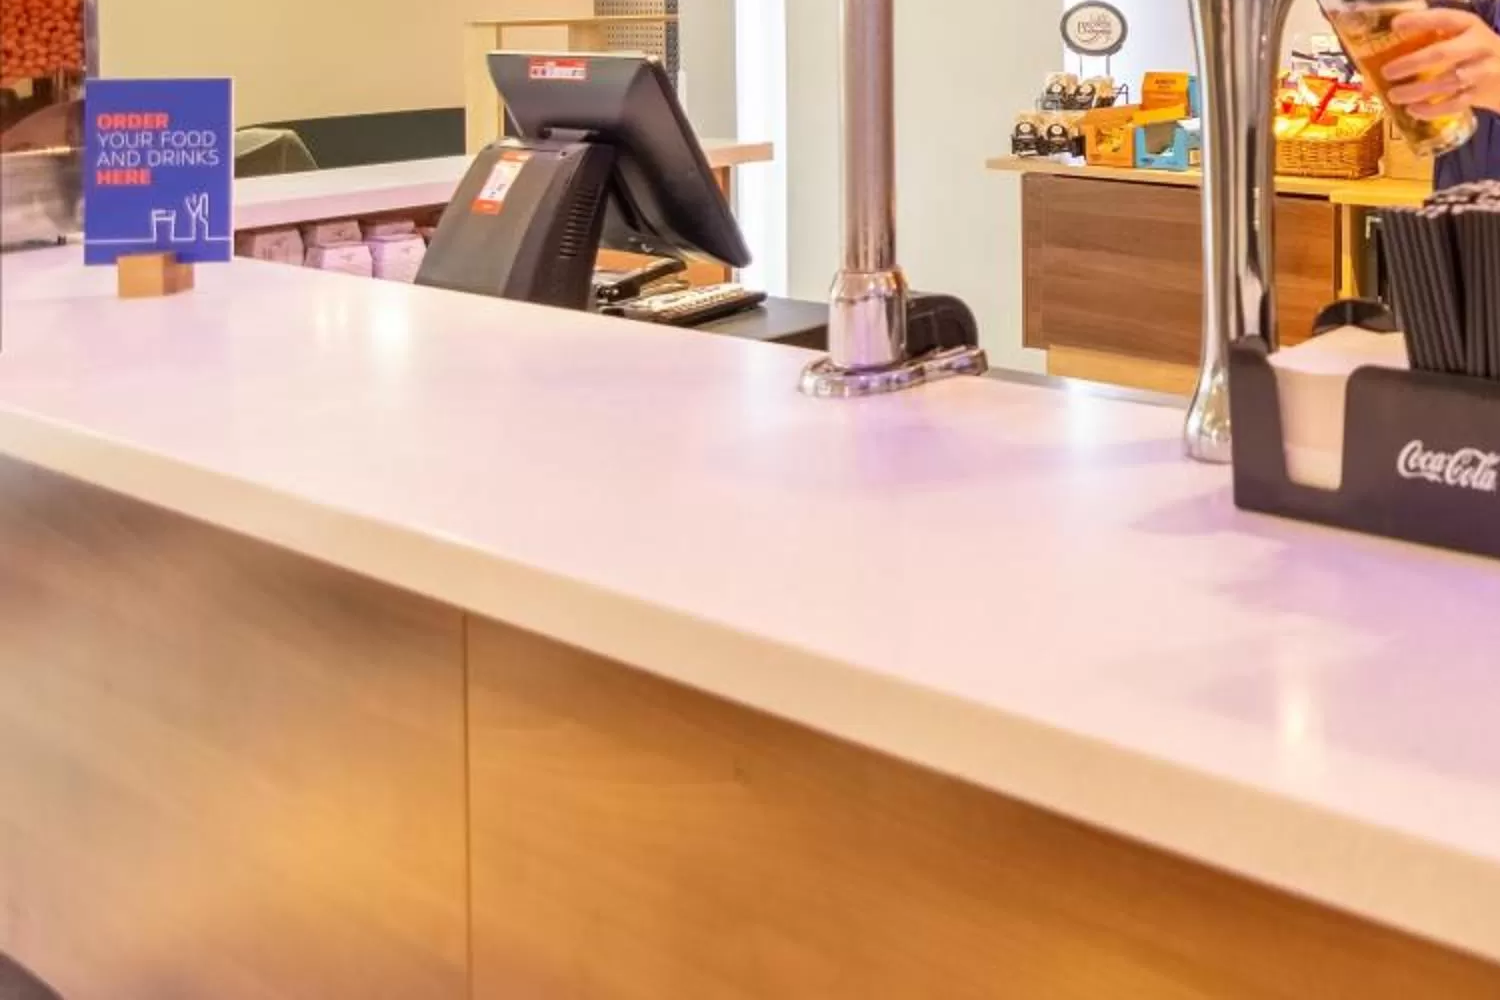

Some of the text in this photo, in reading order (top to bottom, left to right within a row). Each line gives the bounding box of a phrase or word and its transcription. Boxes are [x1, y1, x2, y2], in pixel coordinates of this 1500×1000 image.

[97, 112, 169, 129] ORDER
[97, 130, 217, 149] YOUR FOOD
[97, 149, 220, 167] AND DRINKS
[97, 168, 151, 185] HERE
